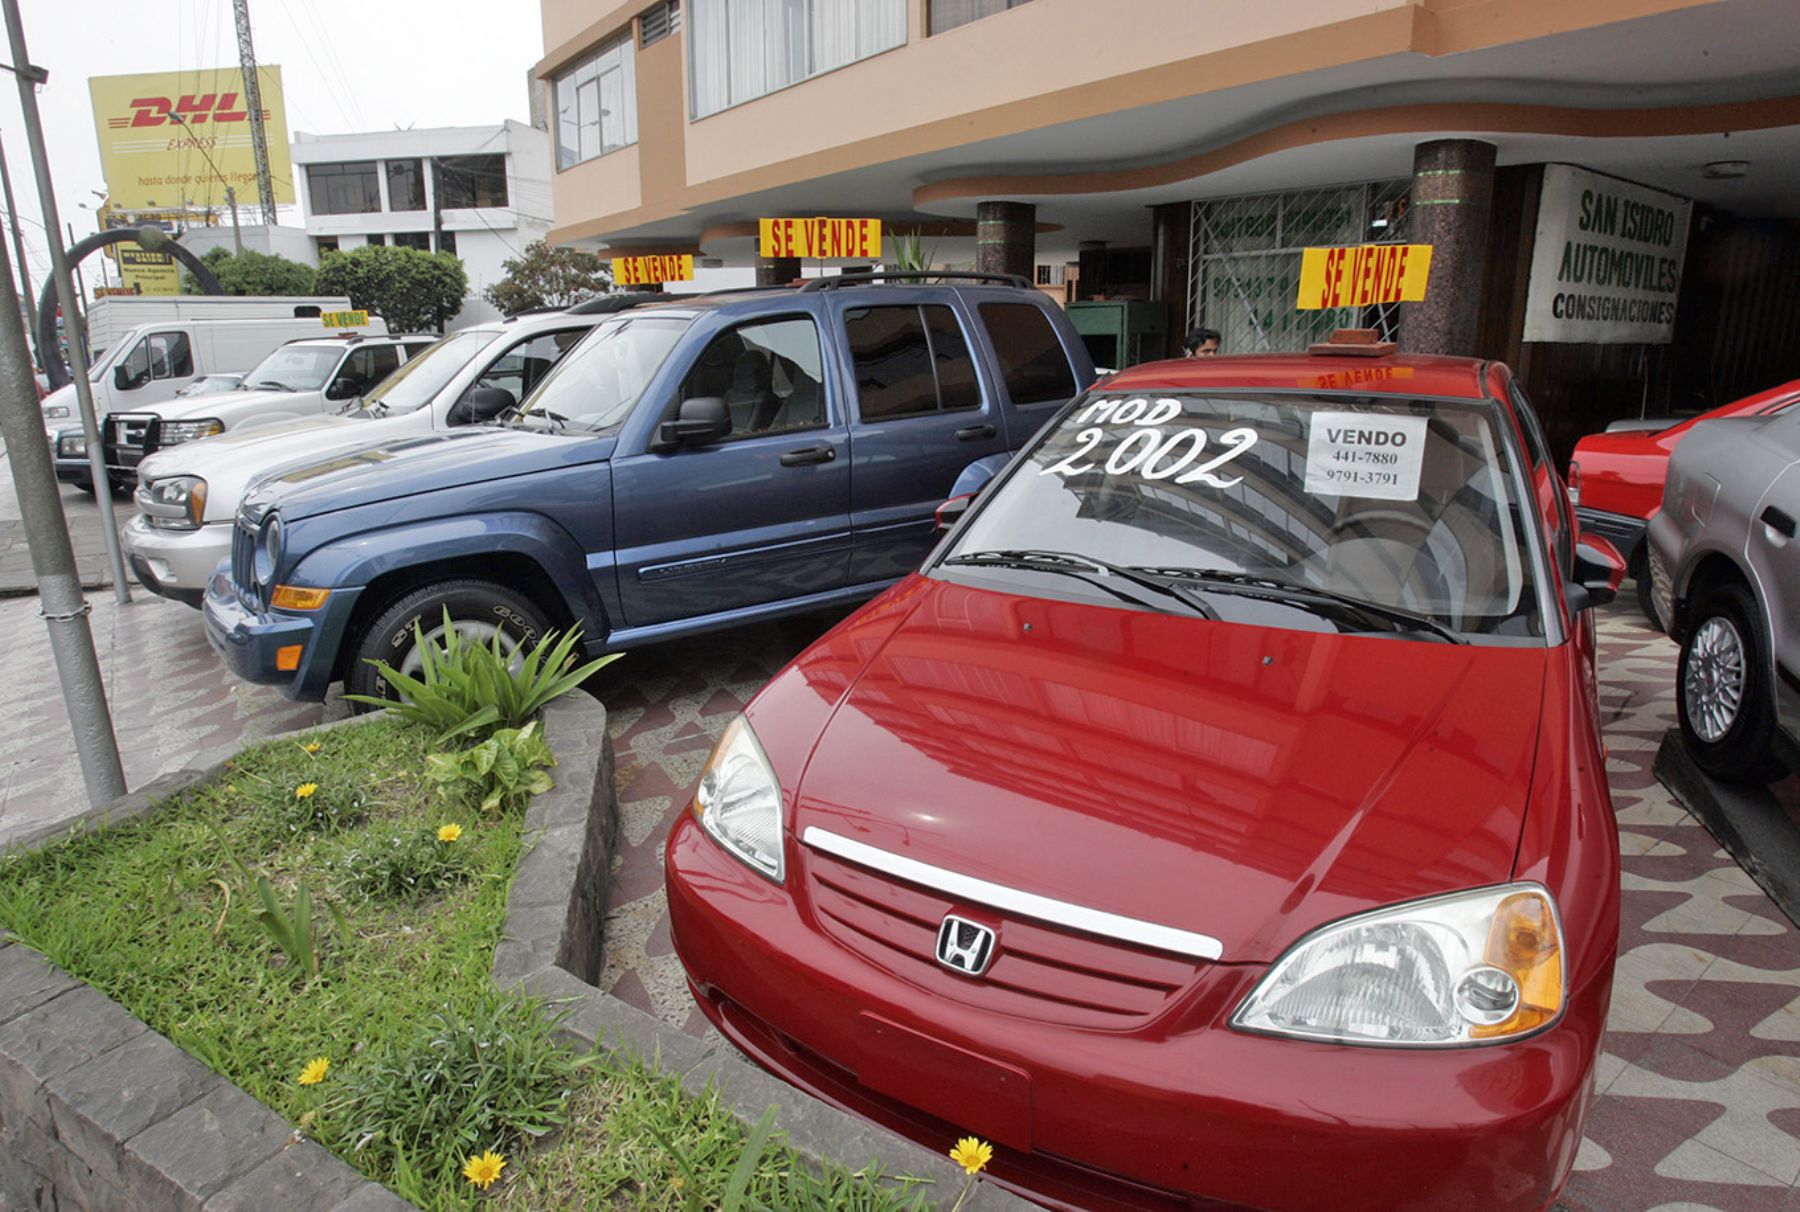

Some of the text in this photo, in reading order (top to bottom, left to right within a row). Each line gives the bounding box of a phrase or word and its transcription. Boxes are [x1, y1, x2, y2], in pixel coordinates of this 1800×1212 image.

[130, 93, 247, 128] DHL
[167, 136, 218, 151] EXPRESS
[138, 176, 163, 185] hasta
[165, 175, 192, 184] donde
[1579, 189, 1674, 248] SAN ISIDRO
[772, 219, 869, 257] SE VENDE
[624, 255, 685, 284] SE VENDE
[1320, 246, 1409, 309] SE VENDE
[1557, 241, 1677, 293] AUTOMOVILES
[322, 311, 367, 327] SE VENDE
[1553, 293, 1674, 324] CONSIGNACIONES
[1077, 399, 1183, 426] MOD
[1326, 428, 1407, 447] VENDO
[1039, 428, 1259, 489] 2002
[1333, 450, 1398, 465] 441-7880
[1327, 470, 1398, 485] 9791-3791
